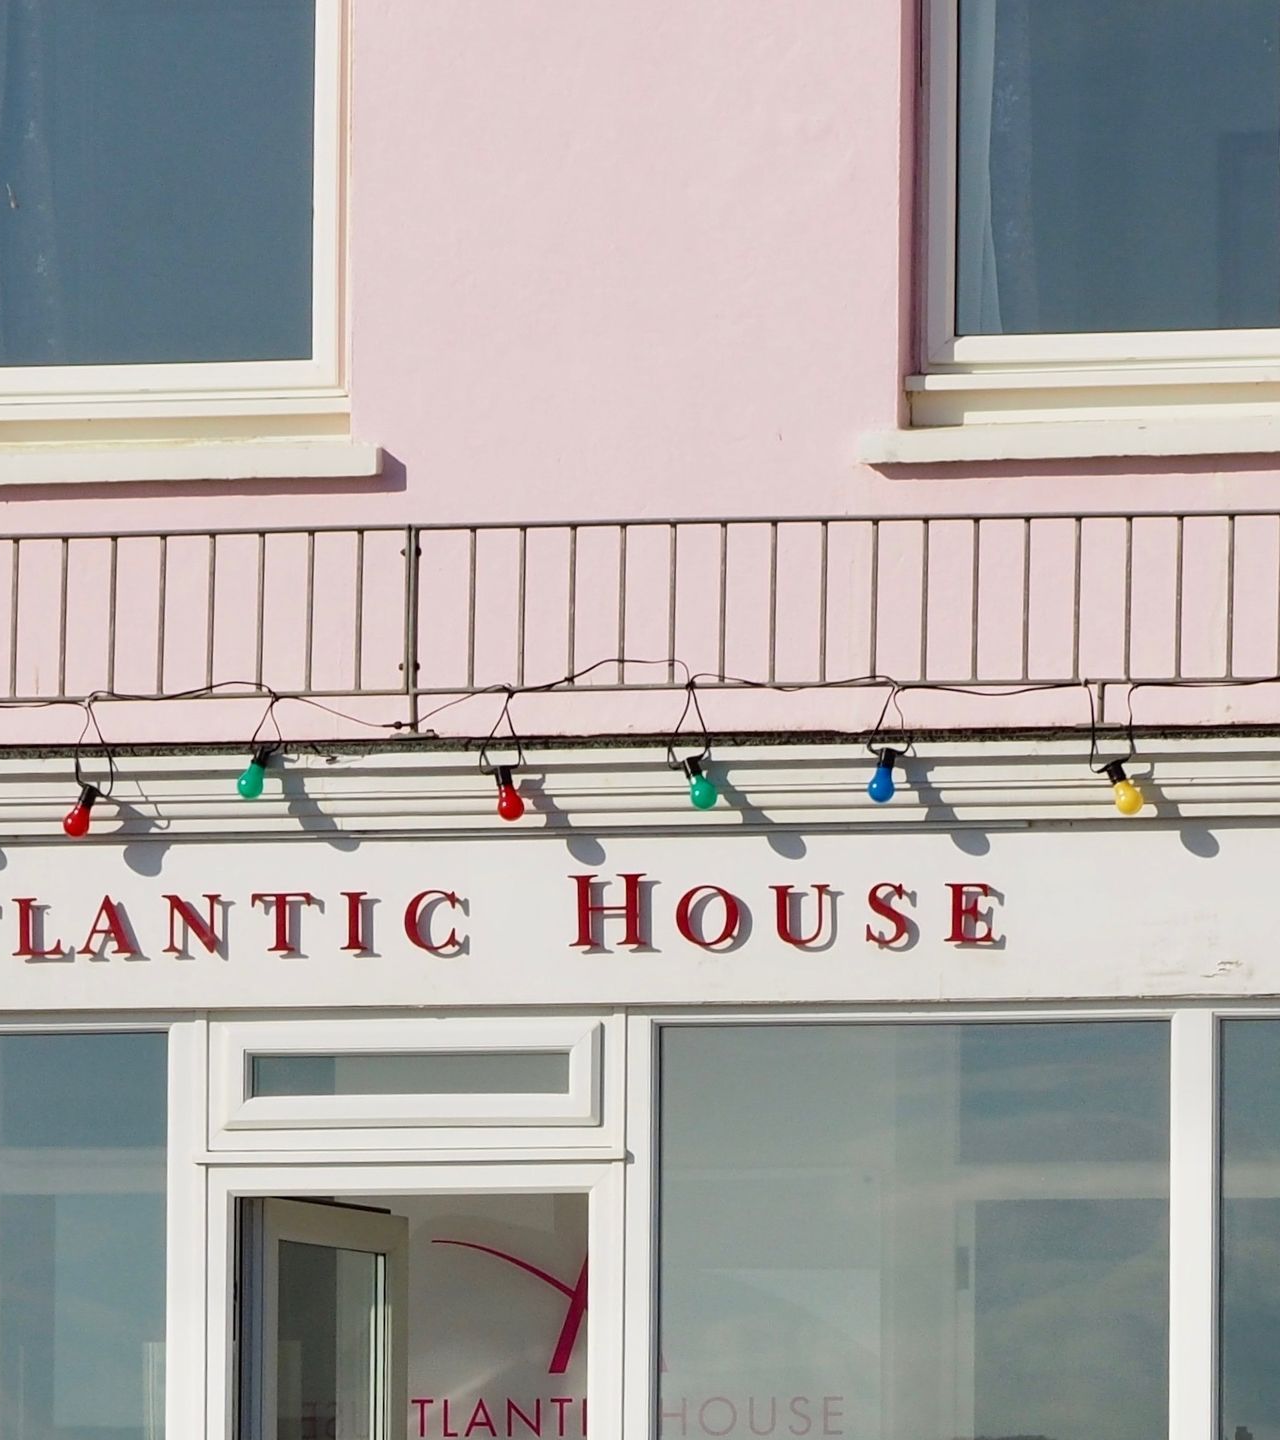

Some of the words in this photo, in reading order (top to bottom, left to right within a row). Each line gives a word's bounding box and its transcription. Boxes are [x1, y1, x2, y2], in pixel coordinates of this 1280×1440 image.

[568, 872, 996, 950] HOUSE
[410, 1397, 587, 1438] TLANTI
[658, 1396, 844, 1436] HOUSE
